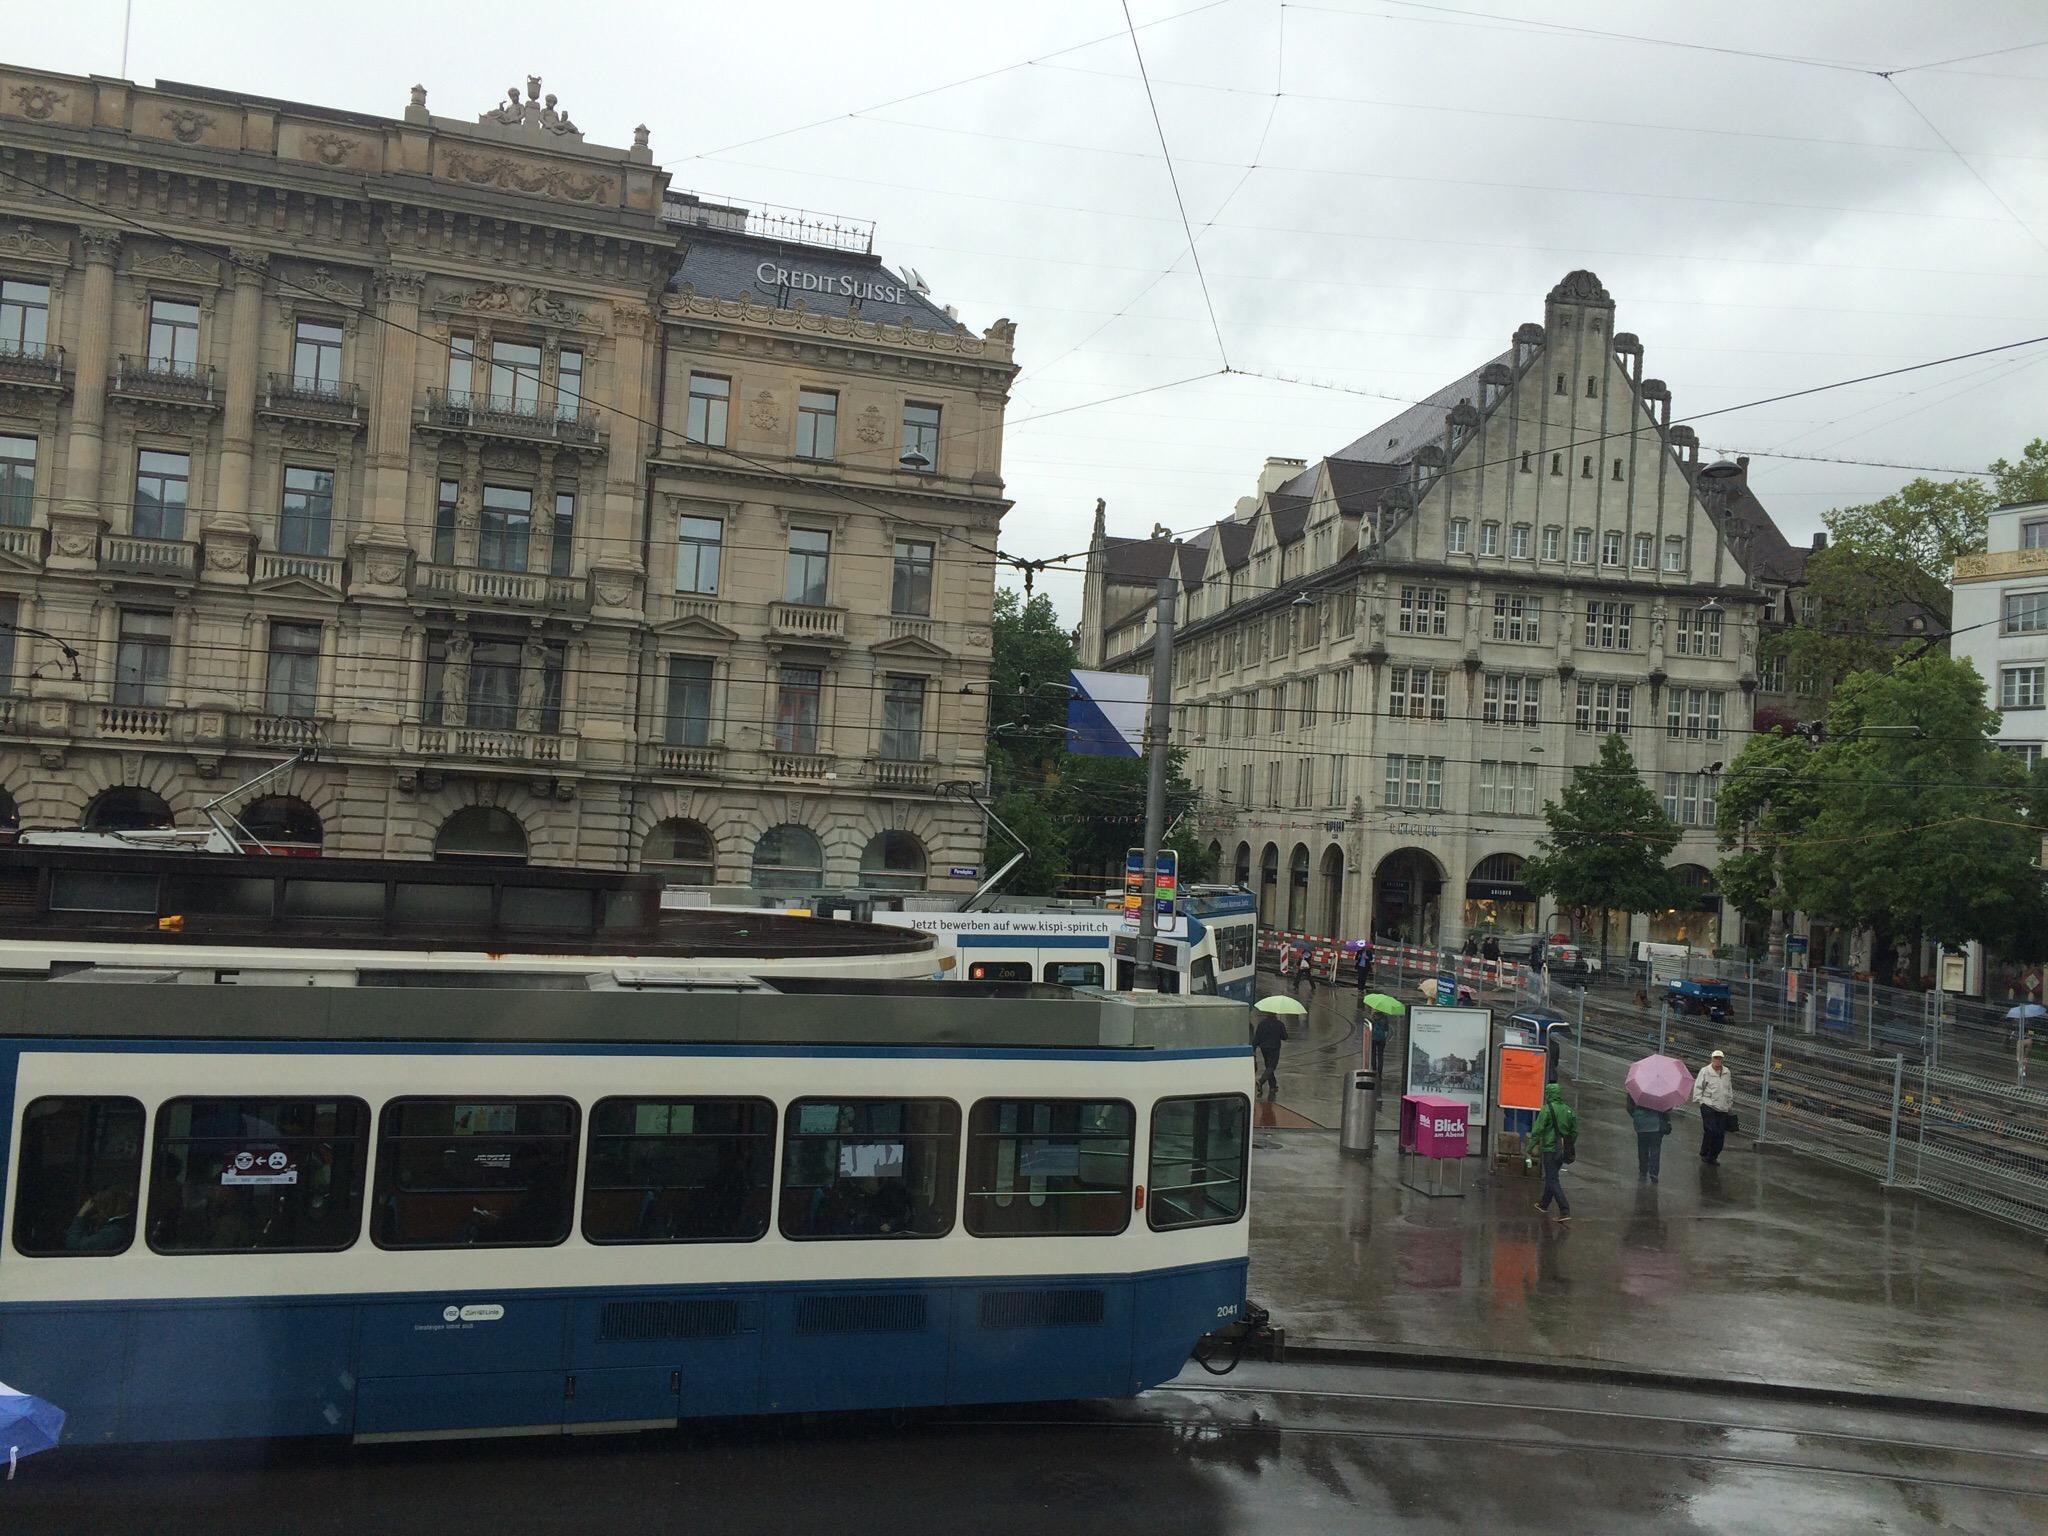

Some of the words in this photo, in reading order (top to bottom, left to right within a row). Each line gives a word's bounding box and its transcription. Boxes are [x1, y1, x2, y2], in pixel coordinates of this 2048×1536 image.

[756, 262, 836, 294] CREDIT
[839, 275, 907, 305] SUISSE
[911, 919, 937, 930] Jetzt
[940, 920, 990, 931] bewerben
[993, 921, 1010, 931] auf
[1013, 921, 1108, 933] www.kispi-spirit.ch
[1434, 1118, 1465, 1132] Blick
[1217, 1304, 1238, 1317] 2041
